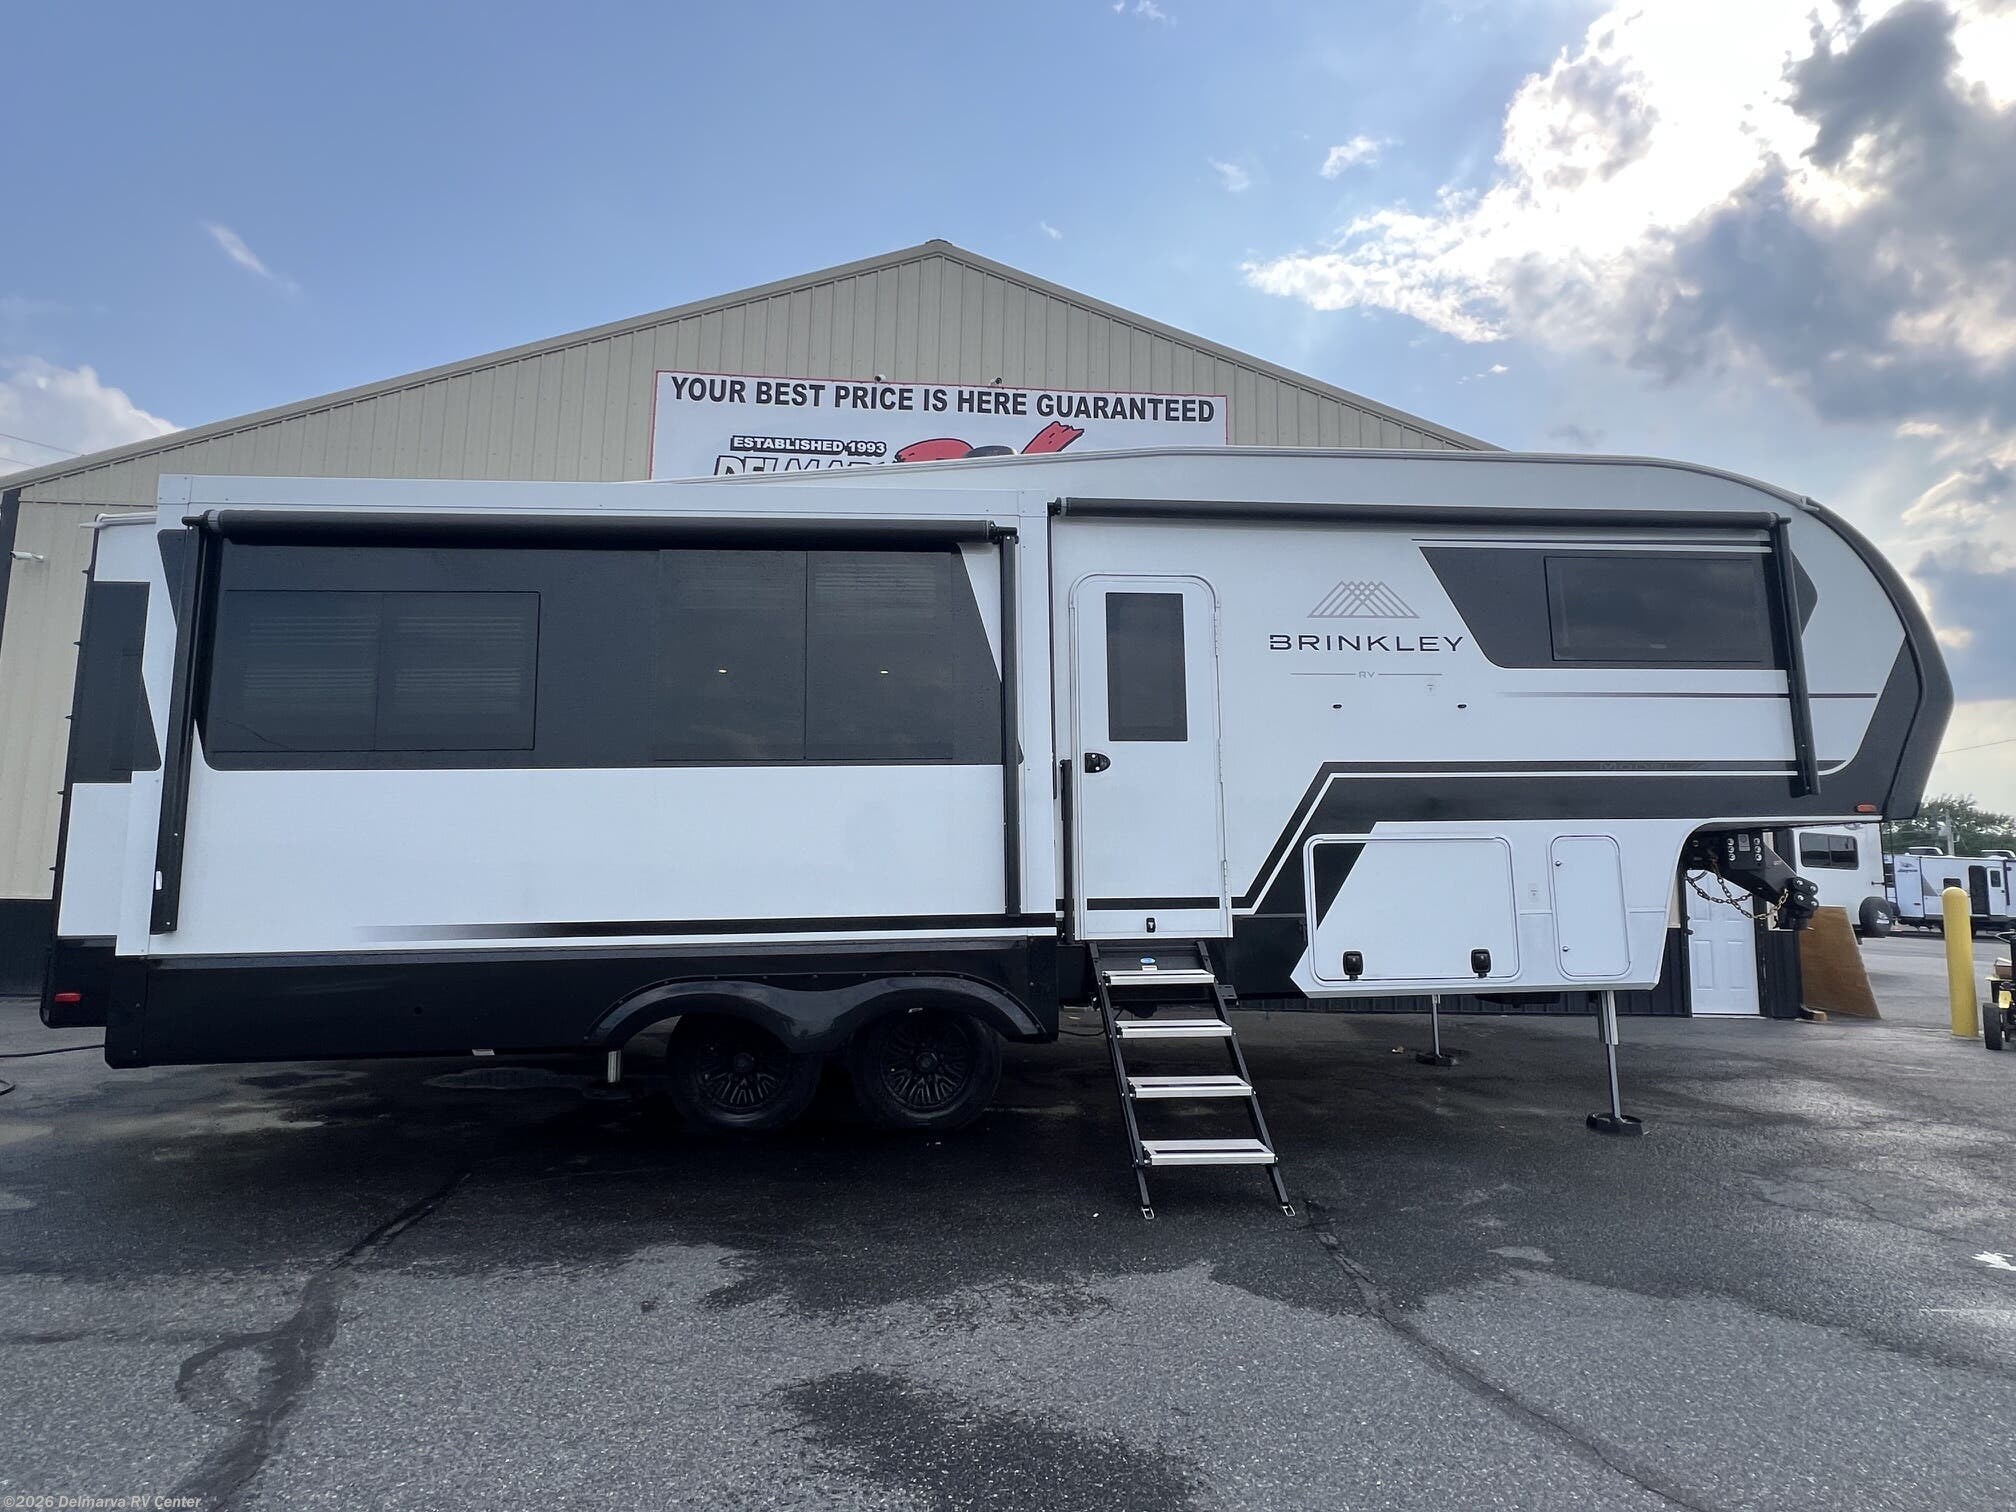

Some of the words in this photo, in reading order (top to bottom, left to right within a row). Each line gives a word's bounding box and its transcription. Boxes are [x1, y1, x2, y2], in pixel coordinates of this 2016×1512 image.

[671, 376, 746, 404] YOUR
[755, 381, 825, 407] BEST
[834, 386, 914, 411] PRICE
[923, 388, 948, 412] IS
[957, 390, 1027, 416] HERE
[1036, 394, 1215, 422] GUARANTEED
[733, 437, 843, 452] ESTABLISHED
[848, 442, 886, 453] 1993
[1269, 634, 1463, 652] BRINKLEY
[1358, 671, 1375, 679] RV
